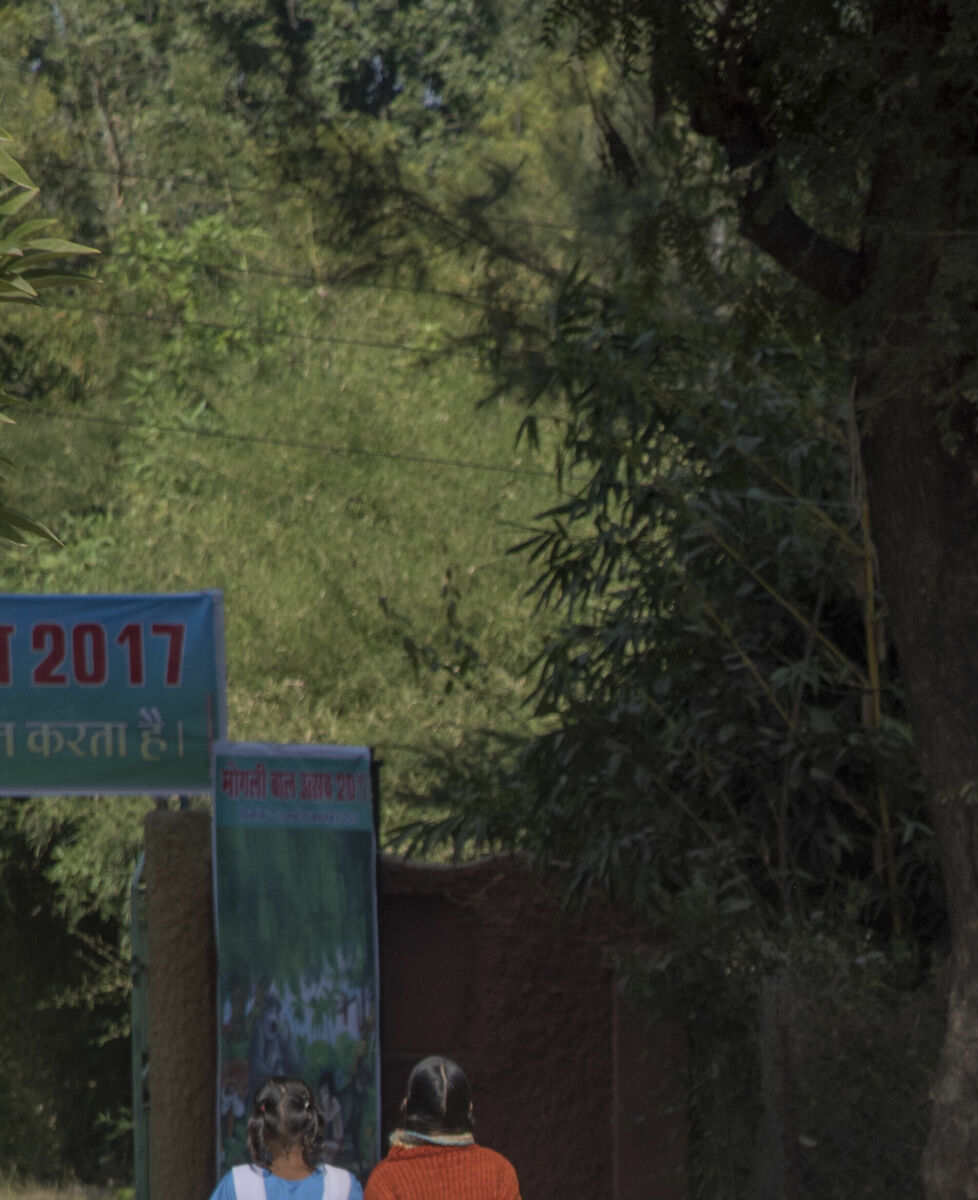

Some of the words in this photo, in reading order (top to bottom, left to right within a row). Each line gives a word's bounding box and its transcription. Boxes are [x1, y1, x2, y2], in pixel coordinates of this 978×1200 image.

[32, 622, 187, 687] 2017
[25, 721, 129, 759] करता
[222, 760, 266, 799] मोगली
